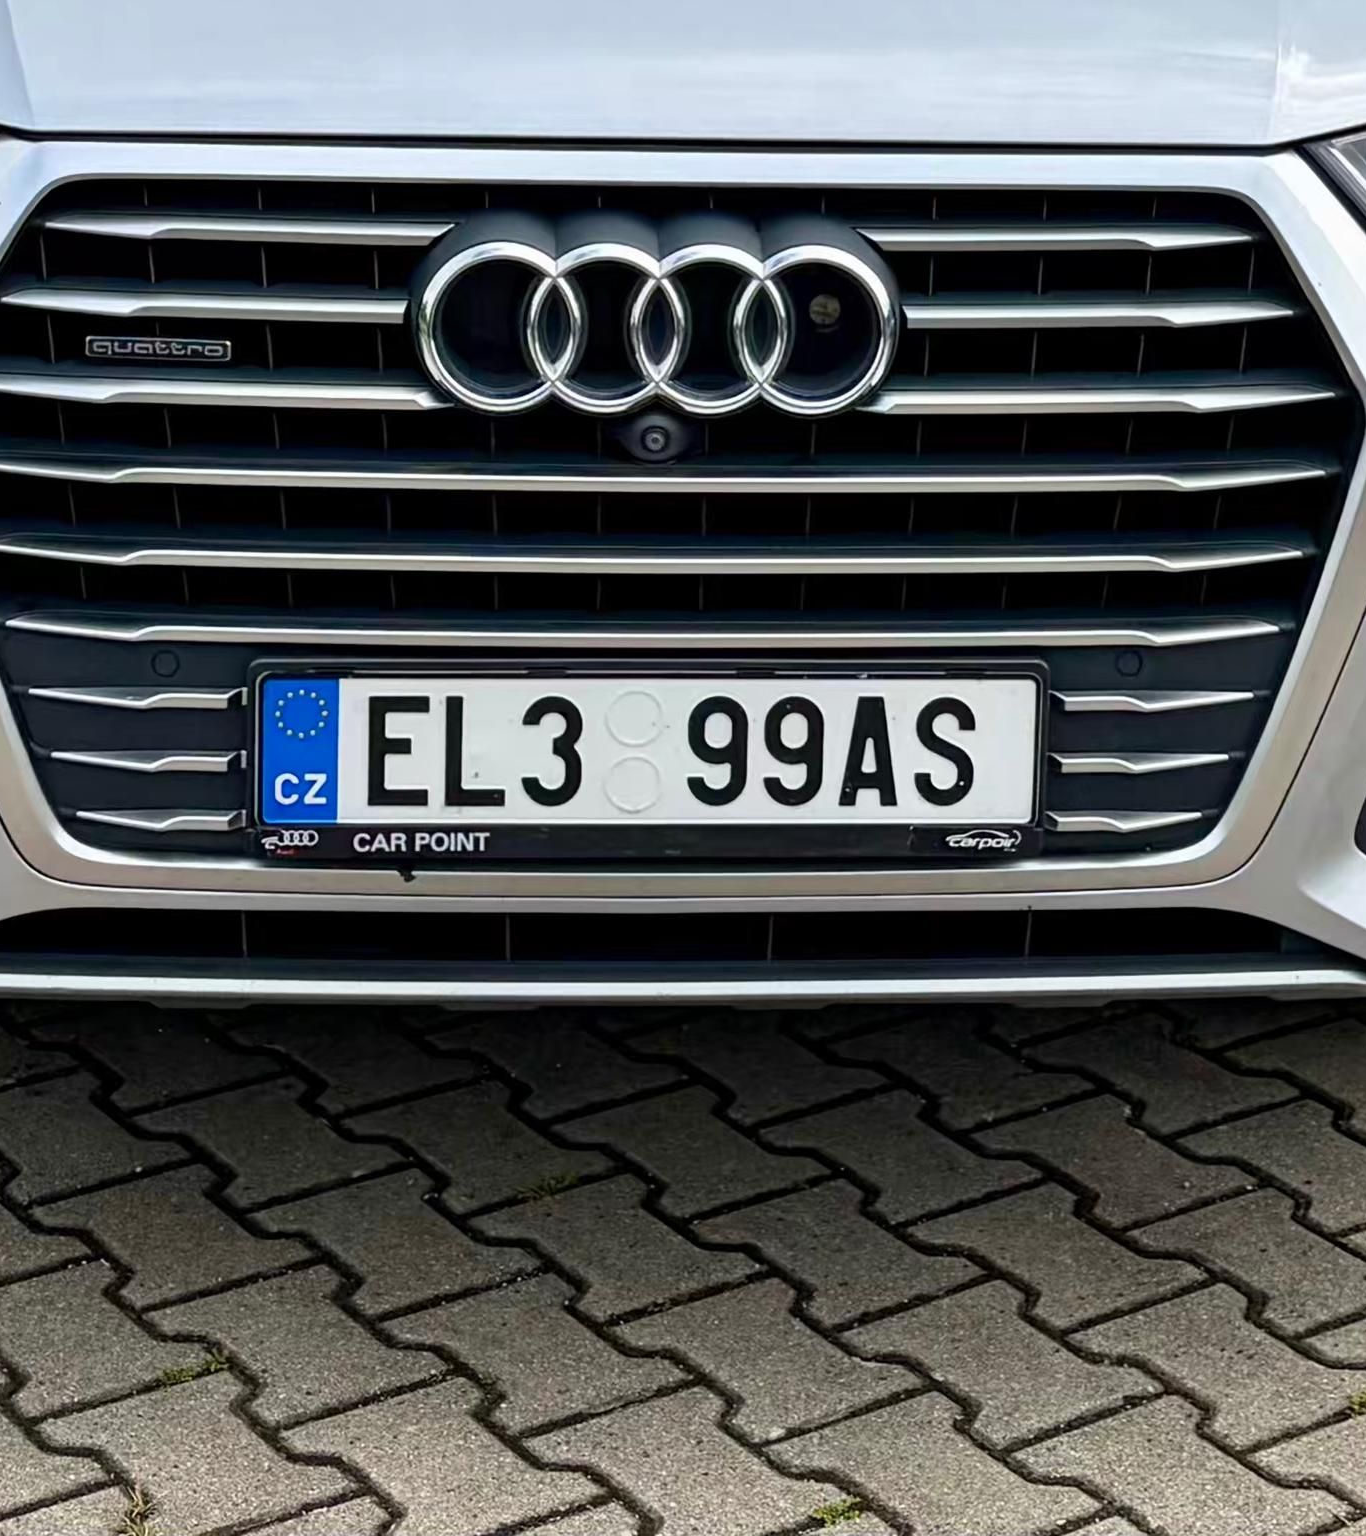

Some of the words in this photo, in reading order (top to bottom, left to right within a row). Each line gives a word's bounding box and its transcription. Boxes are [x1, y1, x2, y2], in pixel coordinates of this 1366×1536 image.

[92, 340, 224, 357] quattro
[367, 696, 584, 806] EL3
[686, 696, 977, 806] 99AS
[275, 773, 327, 805] CZ
[353, 832, 407, 852] CAR
[414, 832, 490, 852] POINT
